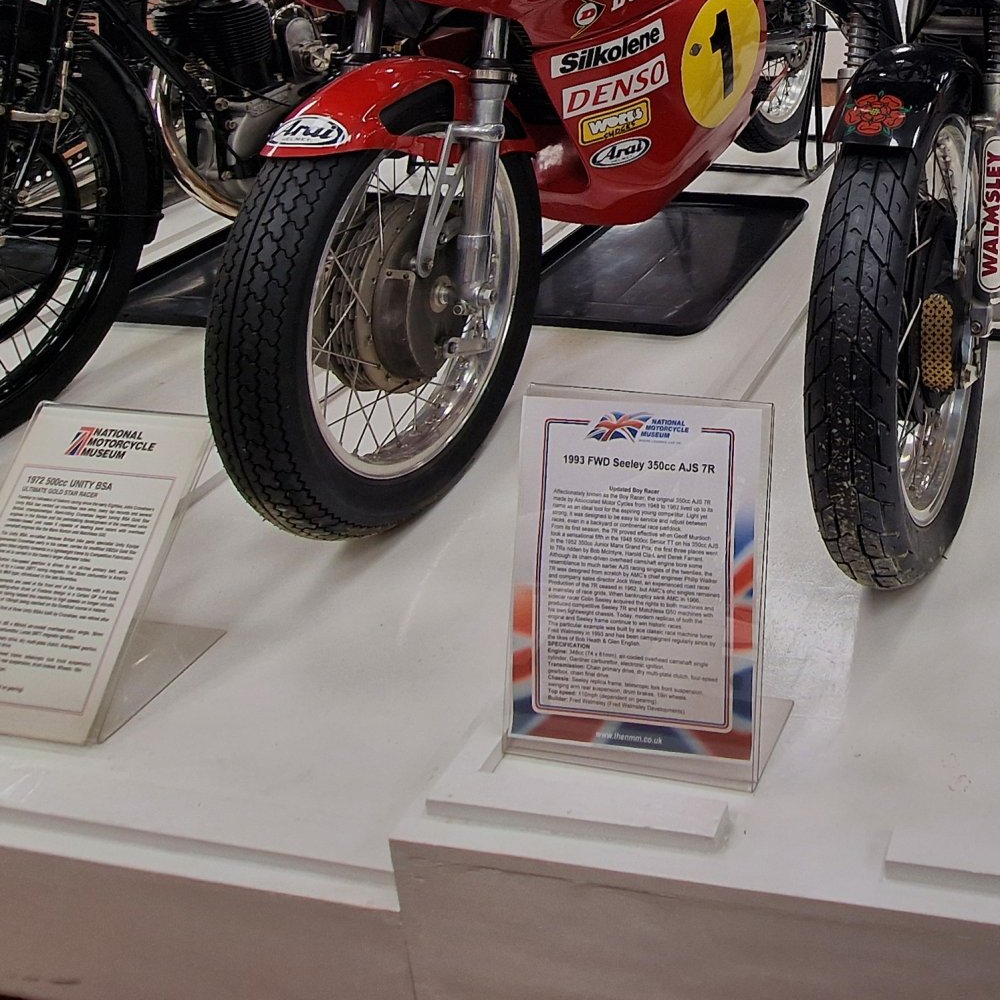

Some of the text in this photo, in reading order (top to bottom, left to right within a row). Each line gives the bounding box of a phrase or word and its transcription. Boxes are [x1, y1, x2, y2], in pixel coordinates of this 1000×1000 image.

[579, 7, 597, 22] D
[559, 26, 660, 74] Silkolene
[710, 9, 734, 99] 1
[567, 60, 665, 114] DENSO
[588, 107, 644, 136] WORKS
[279, 120, 336, 139] Arai
[597, 140, 643, 164] Arai
[645, 425, 689, 433] MOTORCYCLE
[652, 419, 685, 427] NATIONAL
[93, 428, 143, 440] NATIONAL
[87, 437, 157, 451] MOTORCYCLE
[81, 447, 125, 459] MUSEUM
[564, 454, 715, 473] 1993 FWD Seeley 350cc AJS 7R
[25, 475, 114, 490] 1972 500cc UNITY BSA
[595, 731, 662, 745] www.thenmm.co.uk
